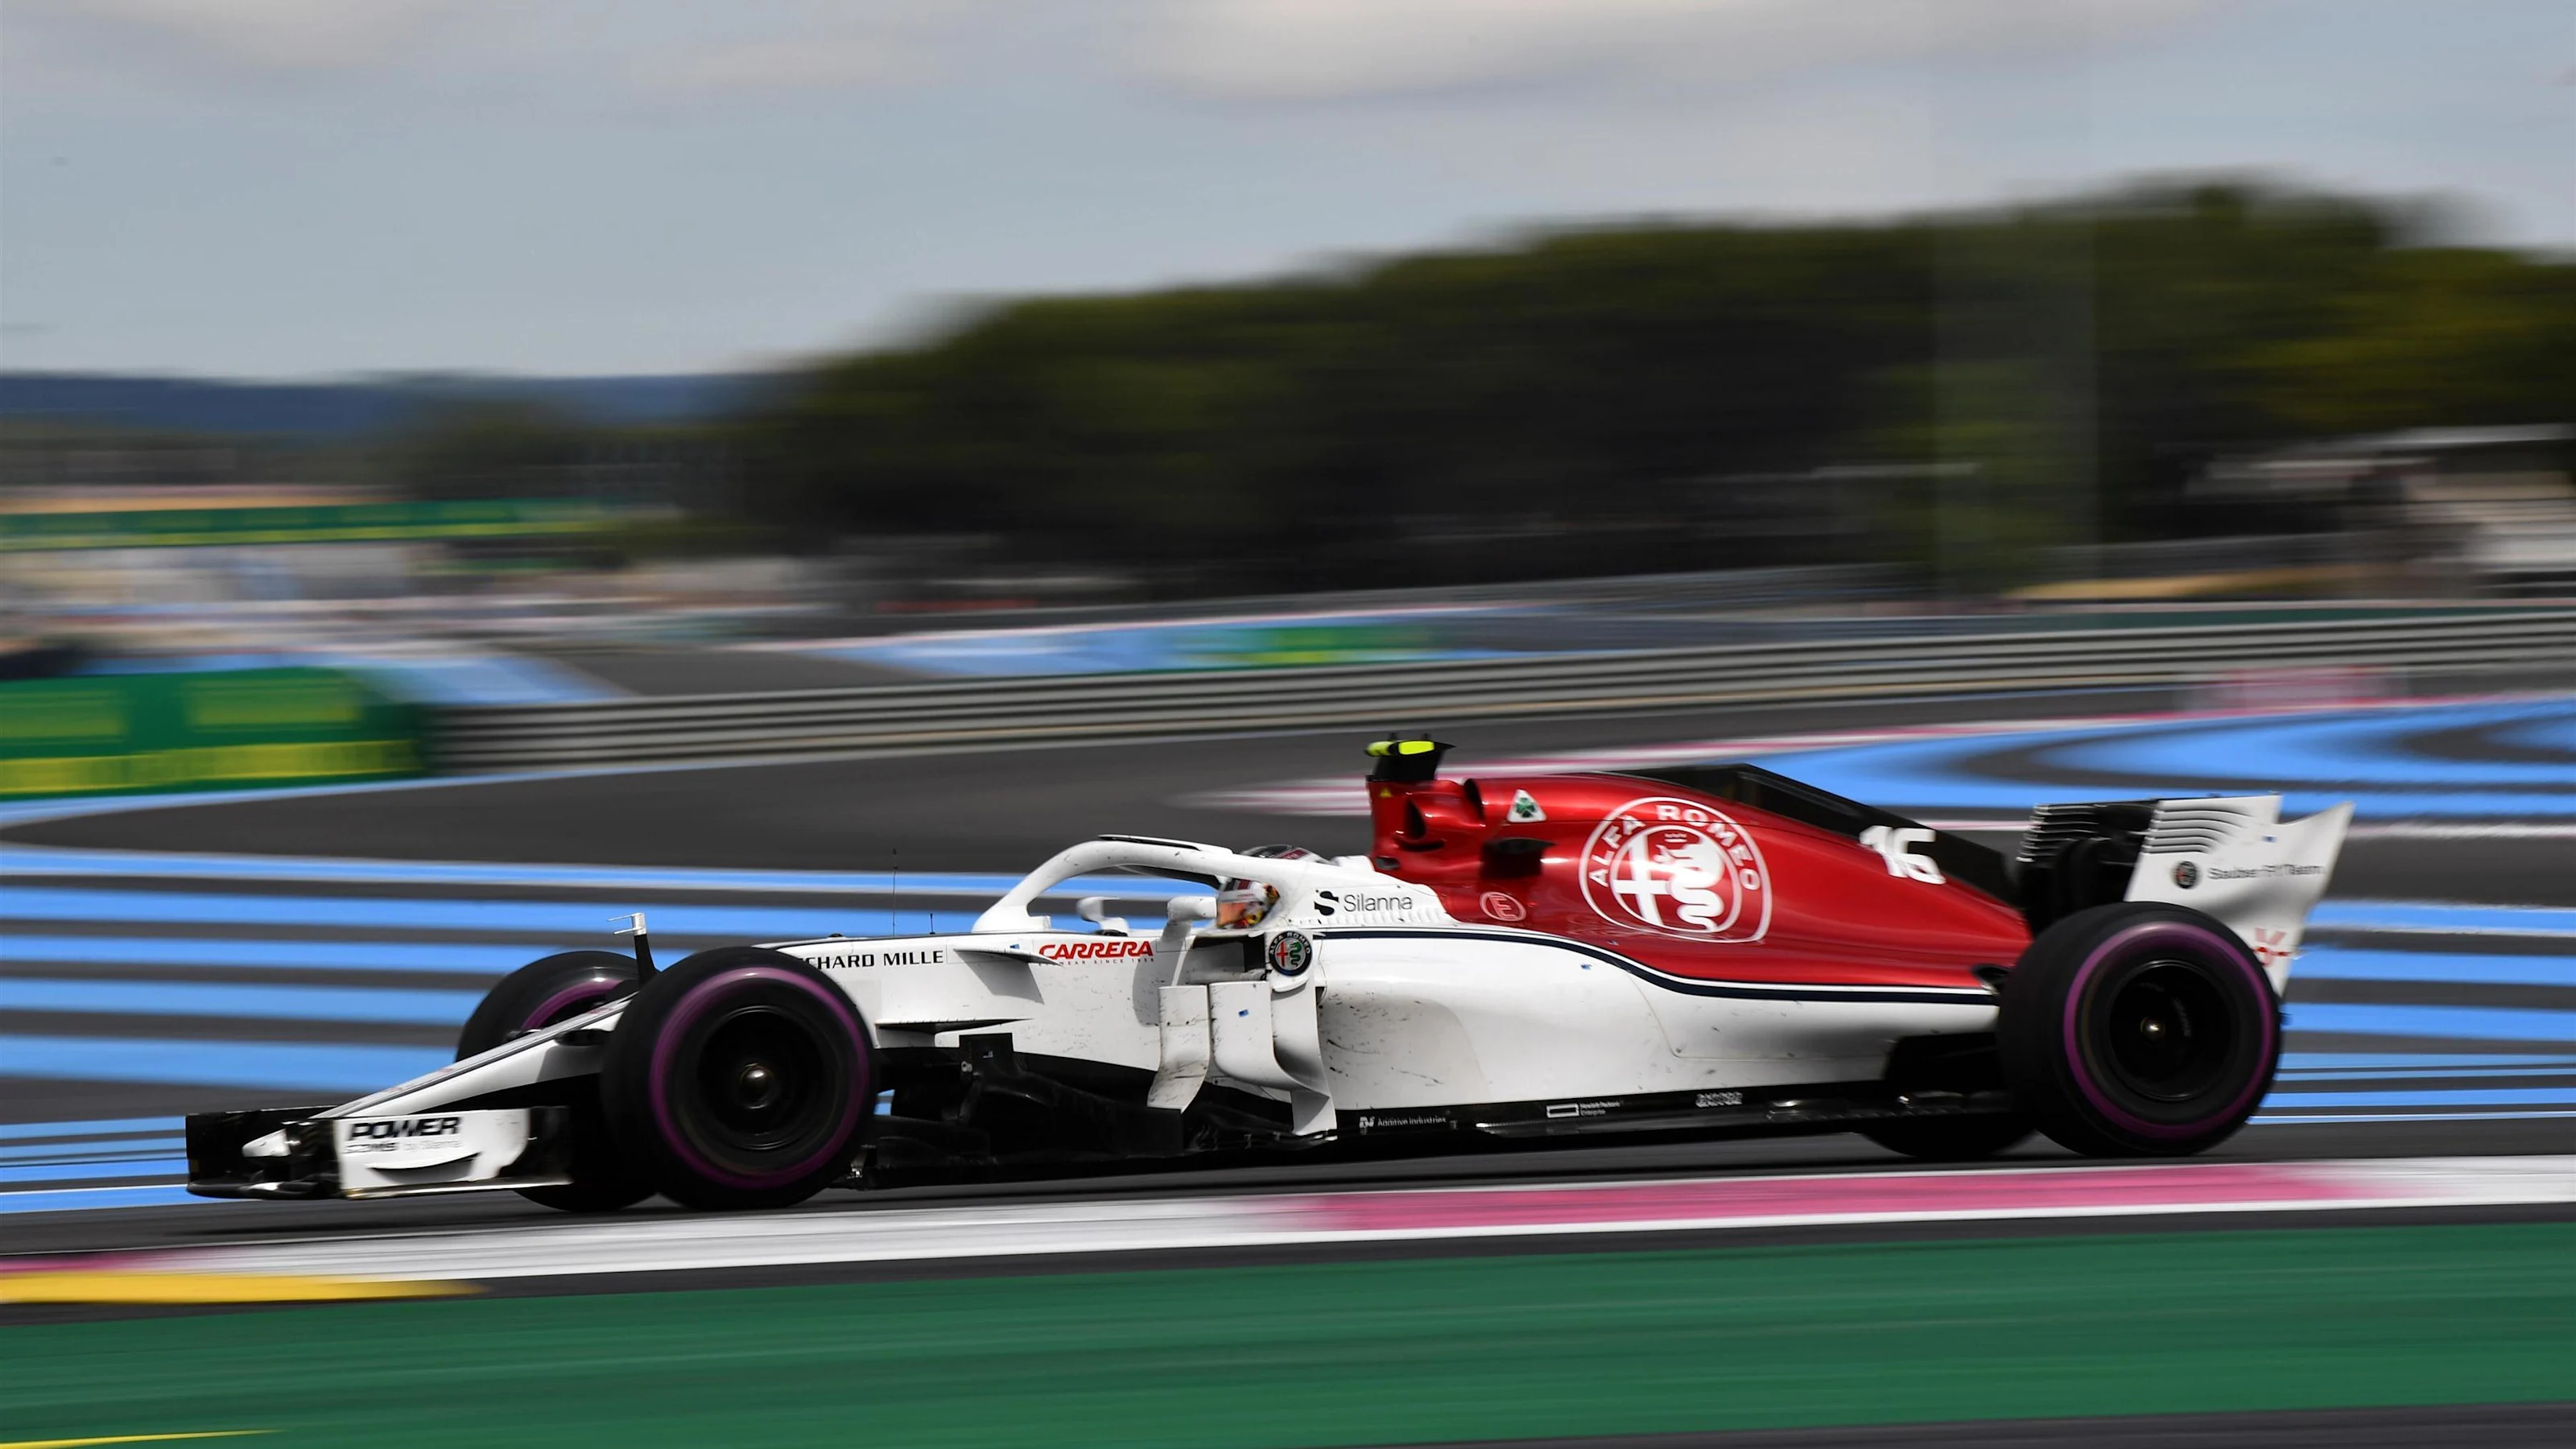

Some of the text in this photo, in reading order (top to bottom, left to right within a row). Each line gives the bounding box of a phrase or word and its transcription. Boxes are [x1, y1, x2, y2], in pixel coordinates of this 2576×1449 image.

[1588, 804, 1761, 891] ALFA ROMEO
[1859, 824, 1946, 885] 16
[1344, 893, 1413, 912] Silanna
[1489, 893, 1518, 919] E
[1038, 940, 1154, 960] CARRERA
[1269, 931, 1311, 955] ALFA ROMEO
[883, 950, 944, 966] MILLE
[348, 1117, 461, 1141] POWER
